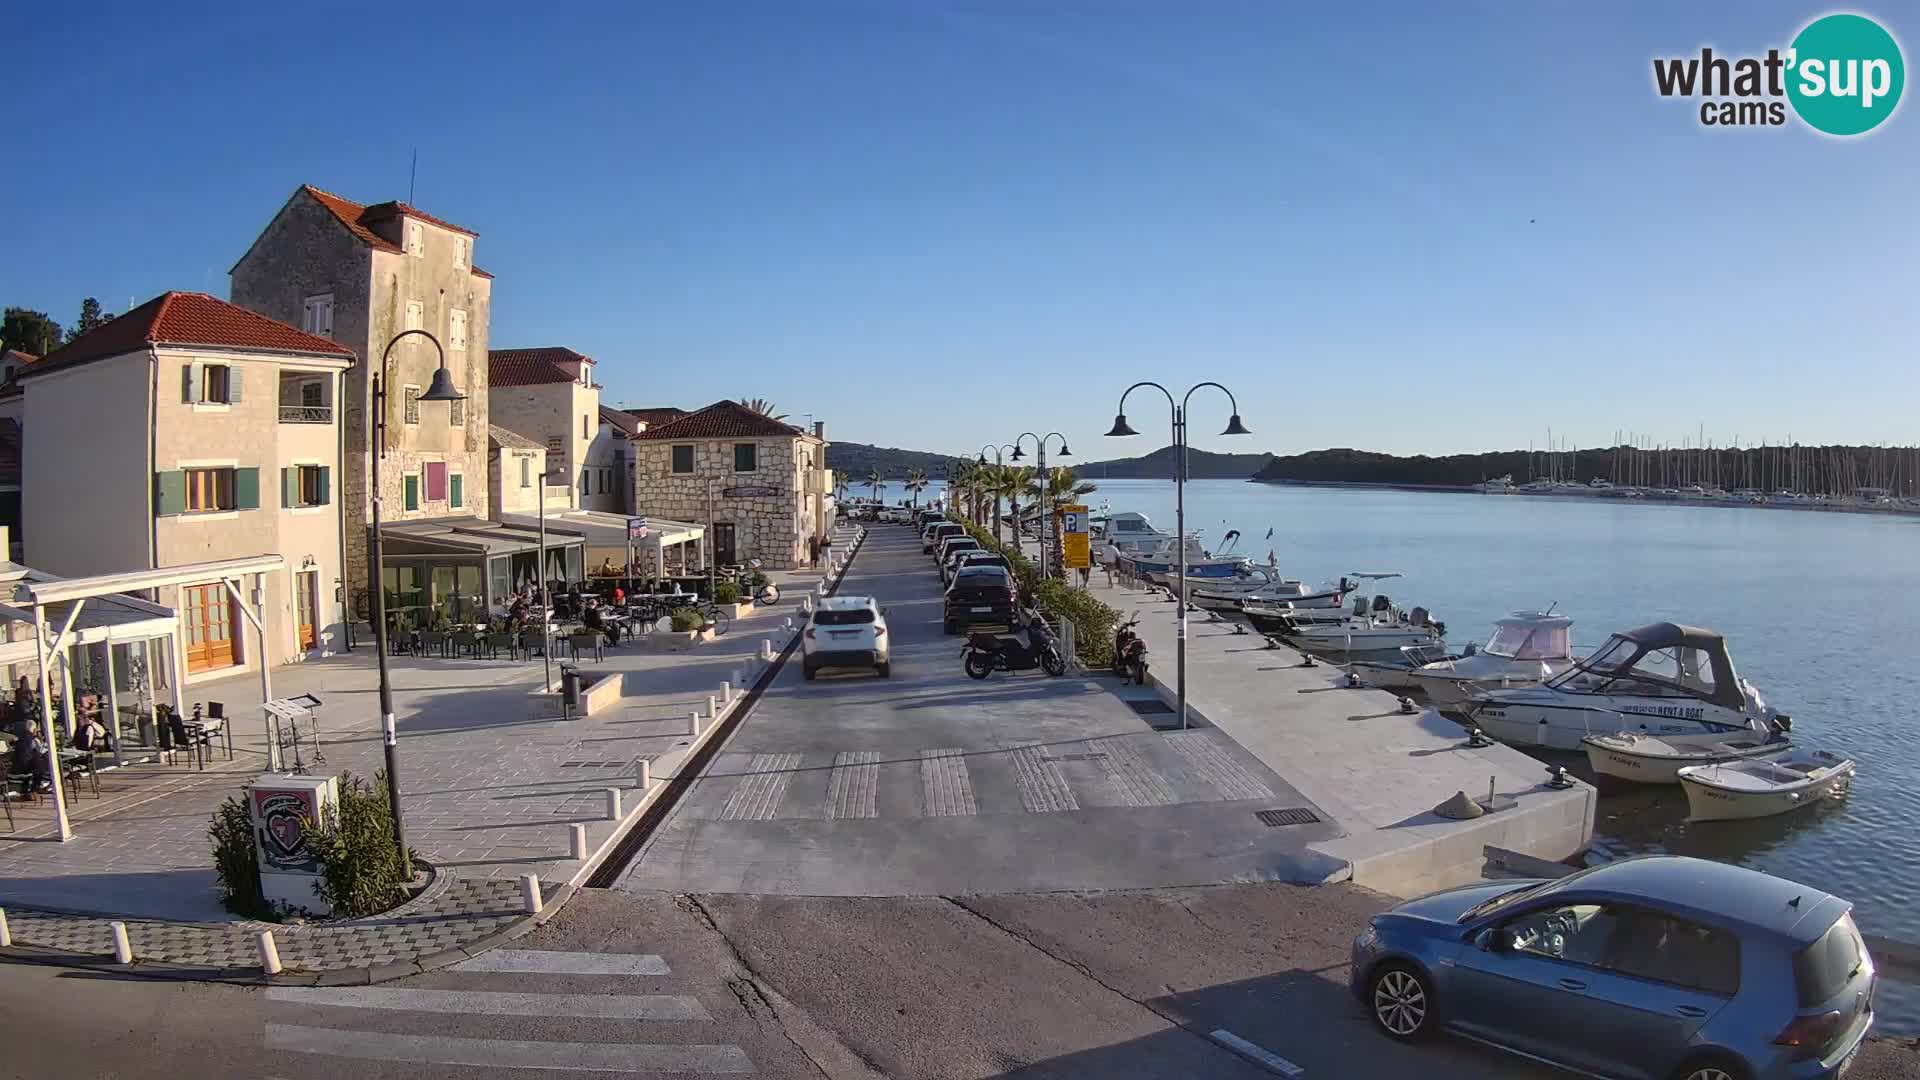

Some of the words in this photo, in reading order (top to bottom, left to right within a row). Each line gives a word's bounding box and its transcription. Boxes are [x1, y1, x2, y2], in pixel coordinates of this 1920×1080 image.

[1066, 515, 1075, 530] P
[1657, 706, 1678, 717] RENT
[1679, 707, 1684, 717] A
[1685, 707, 1705, 719] BOAT
